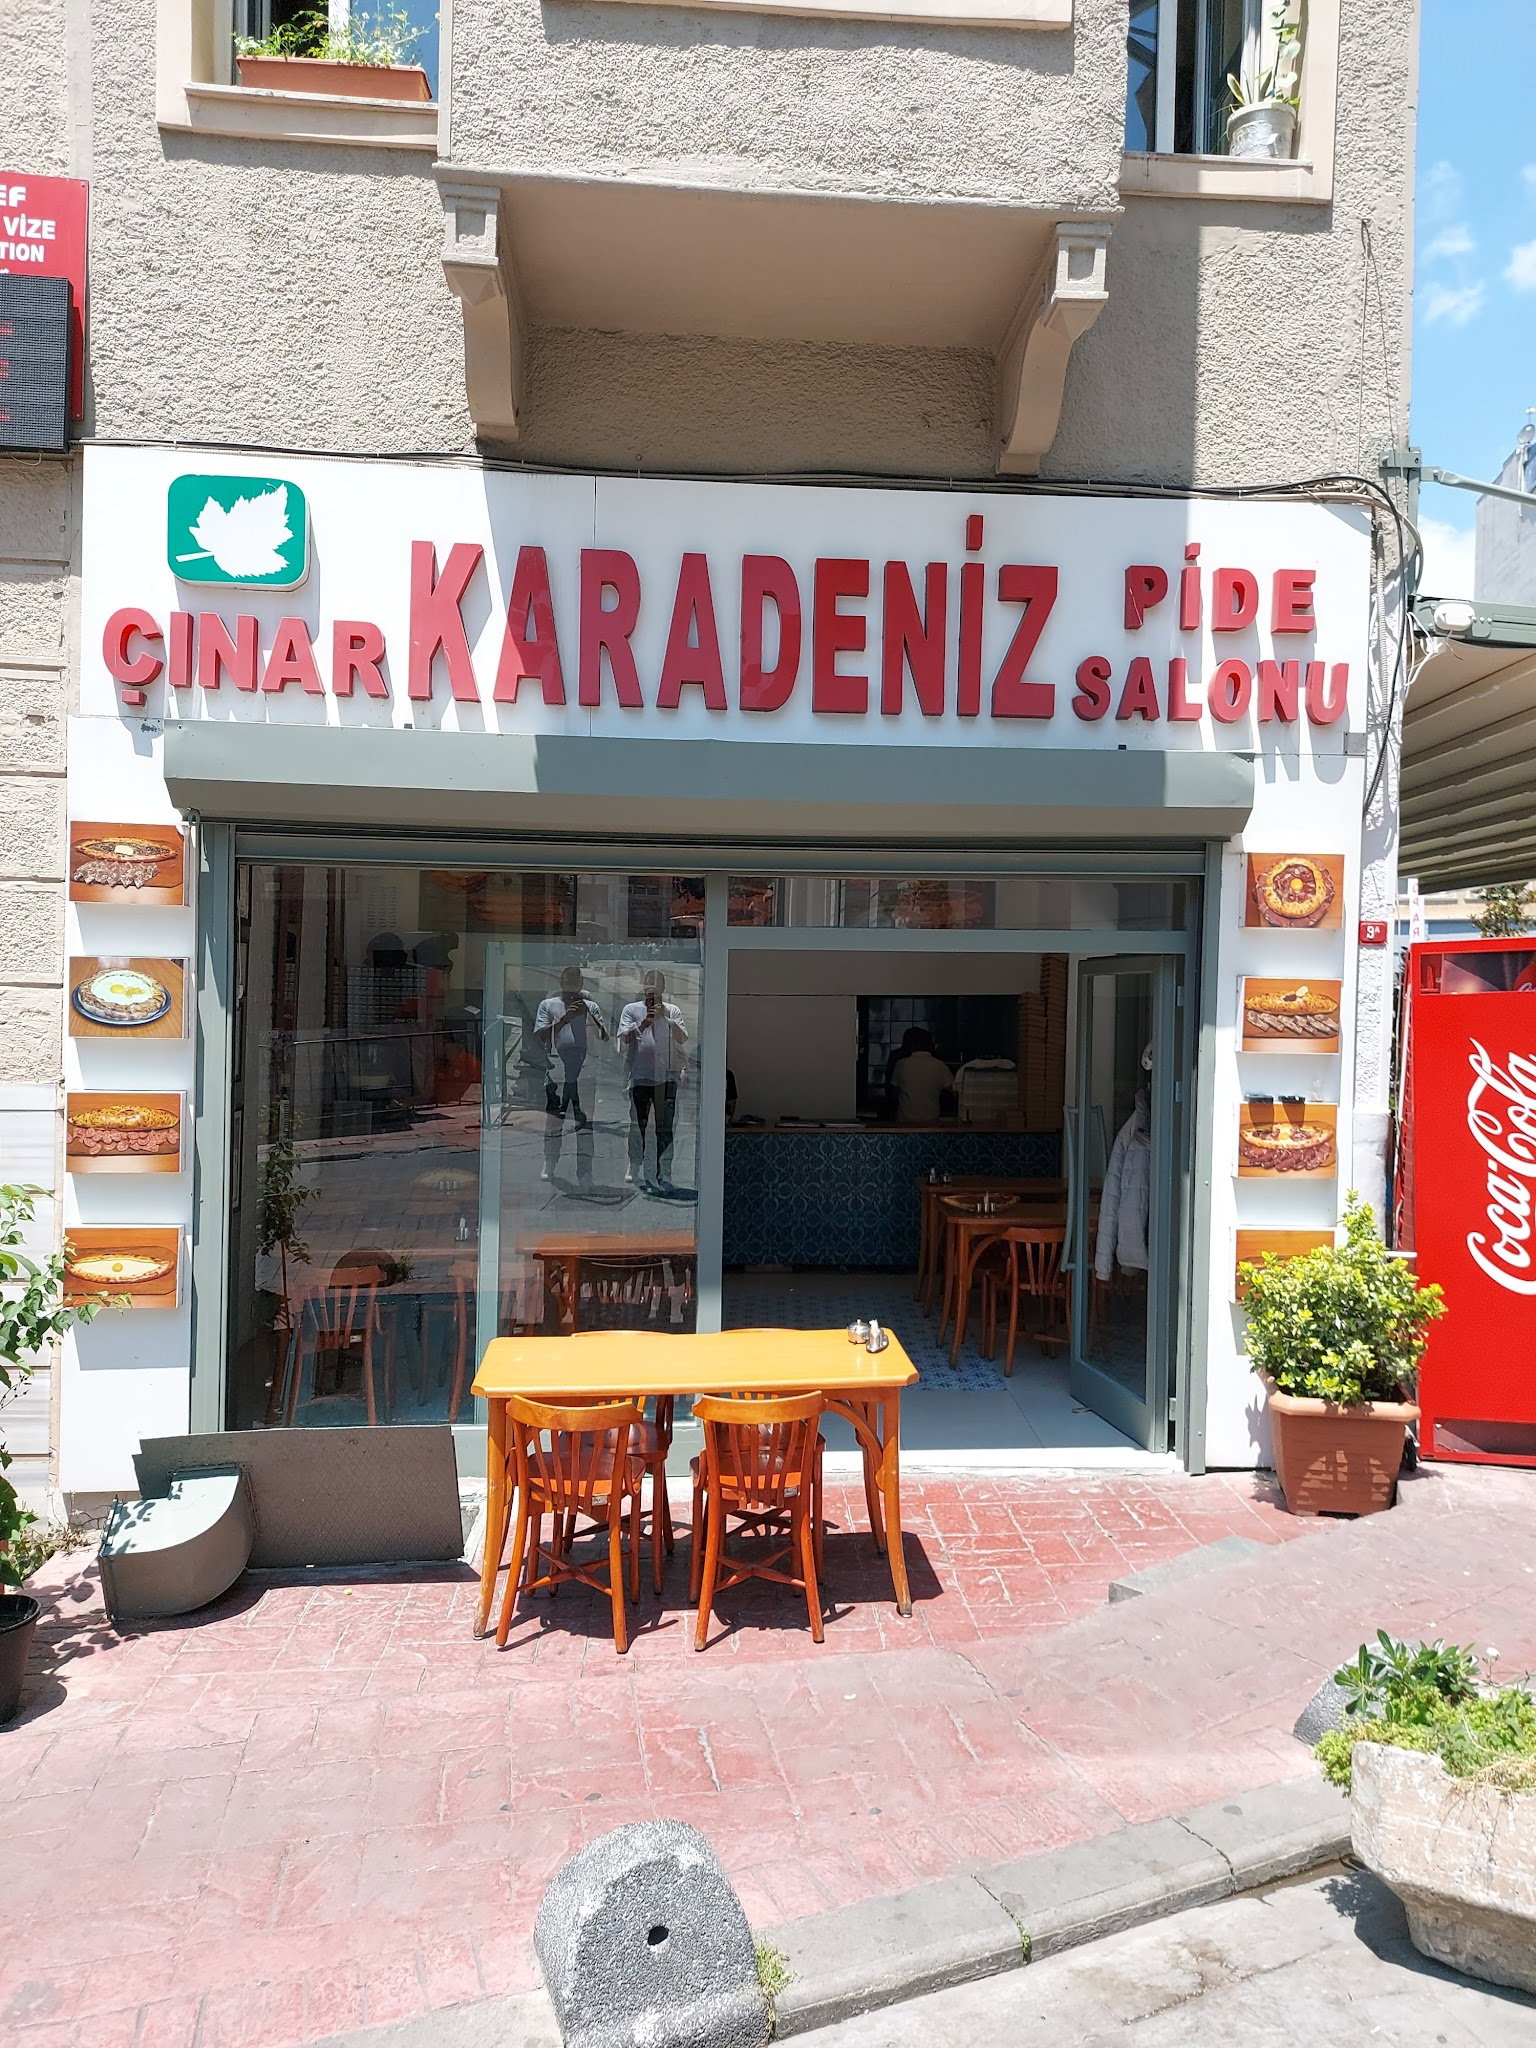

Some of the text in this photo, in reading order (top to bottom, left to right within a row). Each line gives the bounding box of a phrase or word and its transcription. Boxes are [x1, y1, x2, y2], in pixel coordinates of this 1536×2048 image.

[0, 241, 45, 263] TION
[3, 213, 56, 240] VİZE
[103, 515, 1059, 720] ÇINAR KARADENİZ
[1124, 543, 1316, 634] PİDE
[1072, 656, 1349, 726] SALONU
